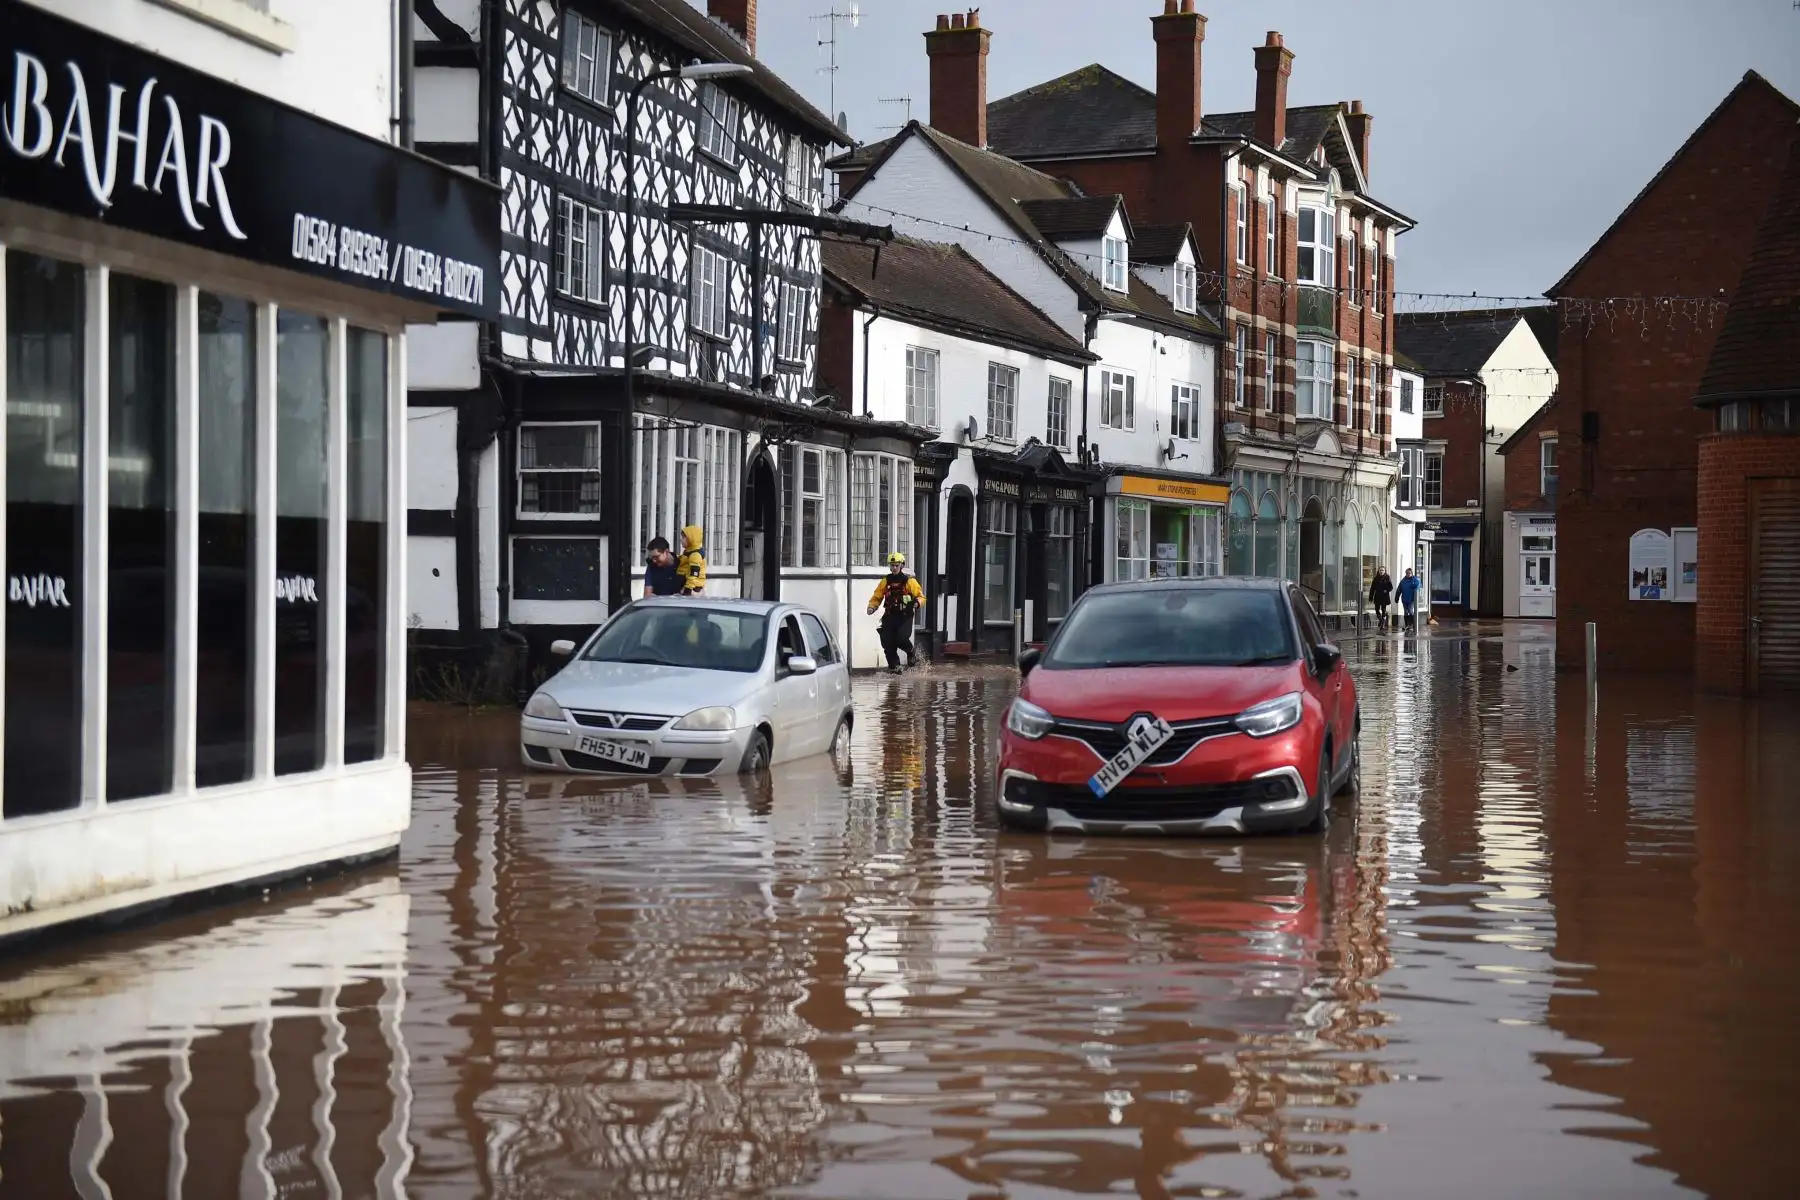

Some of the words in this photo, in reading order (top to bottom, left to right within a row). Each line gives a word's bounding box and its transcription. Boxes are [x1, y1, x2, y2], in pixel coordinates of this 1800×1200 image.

[2, 51, 248, 239] BAHAR
[292, 213, 337, 267] 01584
[338, 226, 389, 281] 819364
[403, 246, 442, 294] 01584
[444, 258, 484, 305] 810271
[984, 479, 1020, 496] SINGAPORE
[9, 572, 72, 608] BAHAR
[276, 574, 319, 603] BAHAR
[580, 737, 615, 757] FH53
[619, 746, 646, 765] YJM
[1097, 746, 1136, 787] HV67
[1134, 721, 1168, 753] WLX
